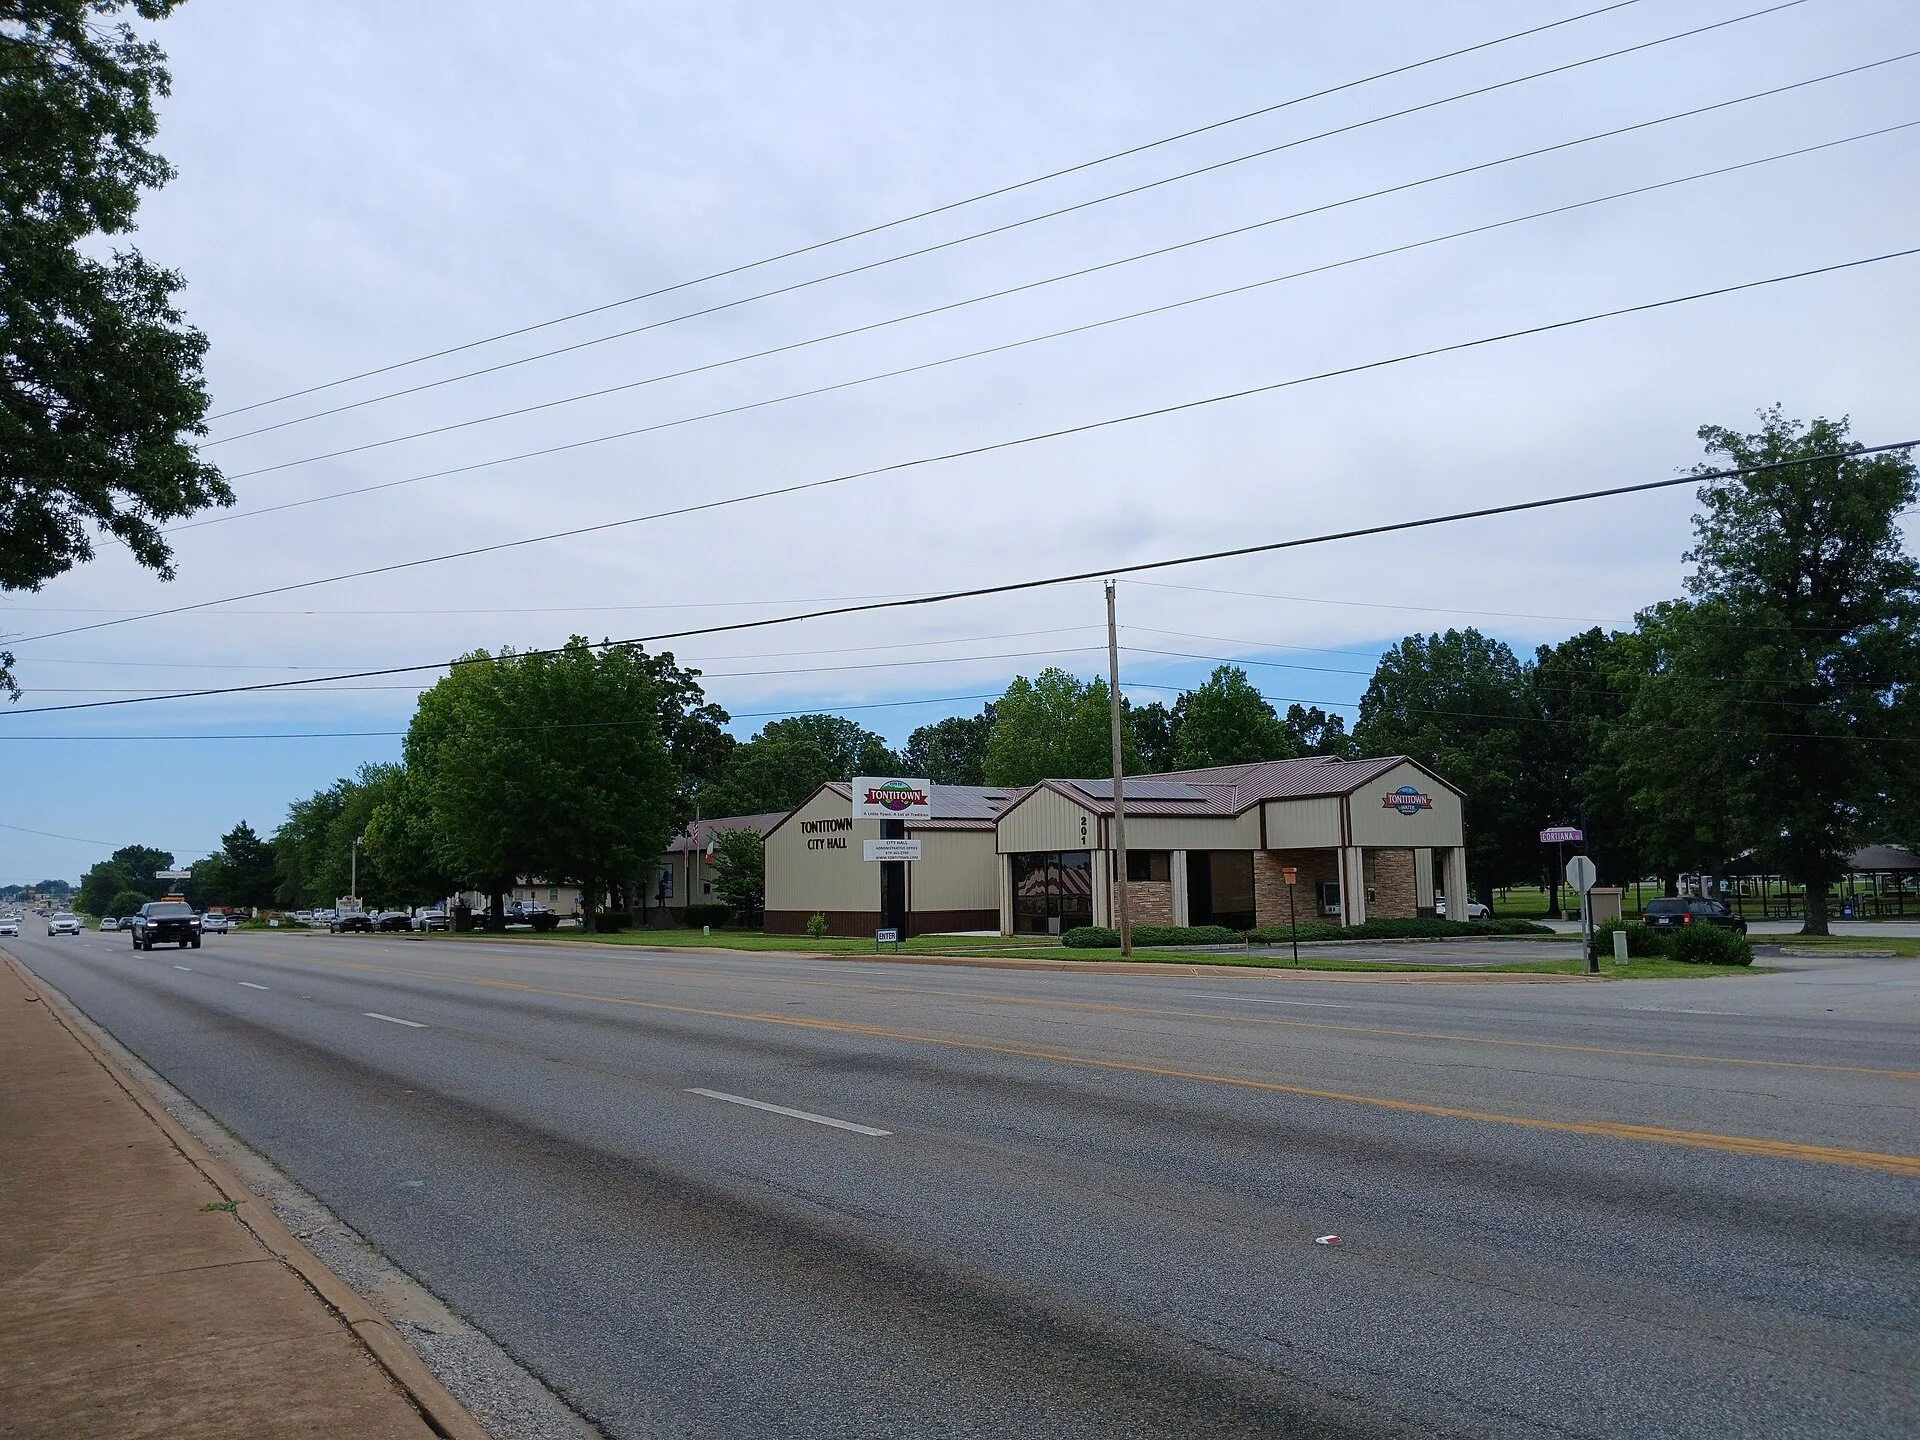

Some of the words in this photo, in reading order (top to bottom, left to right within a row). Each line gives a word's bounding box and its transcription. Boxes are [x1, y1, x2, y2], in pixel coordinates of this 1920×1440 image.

[870, 790, 921, 800] TONTITOWN
[1388, 794, 1427, 804] TONTITOWN
[800, 817, 853, 834] TONTITOWN
[1542, 832, 1574, 841] CORTIANA
[807, 838, 825, 850] CITY
[826, 837, 848, 849] HALL
[879, 932, 896, 940] ENTER
